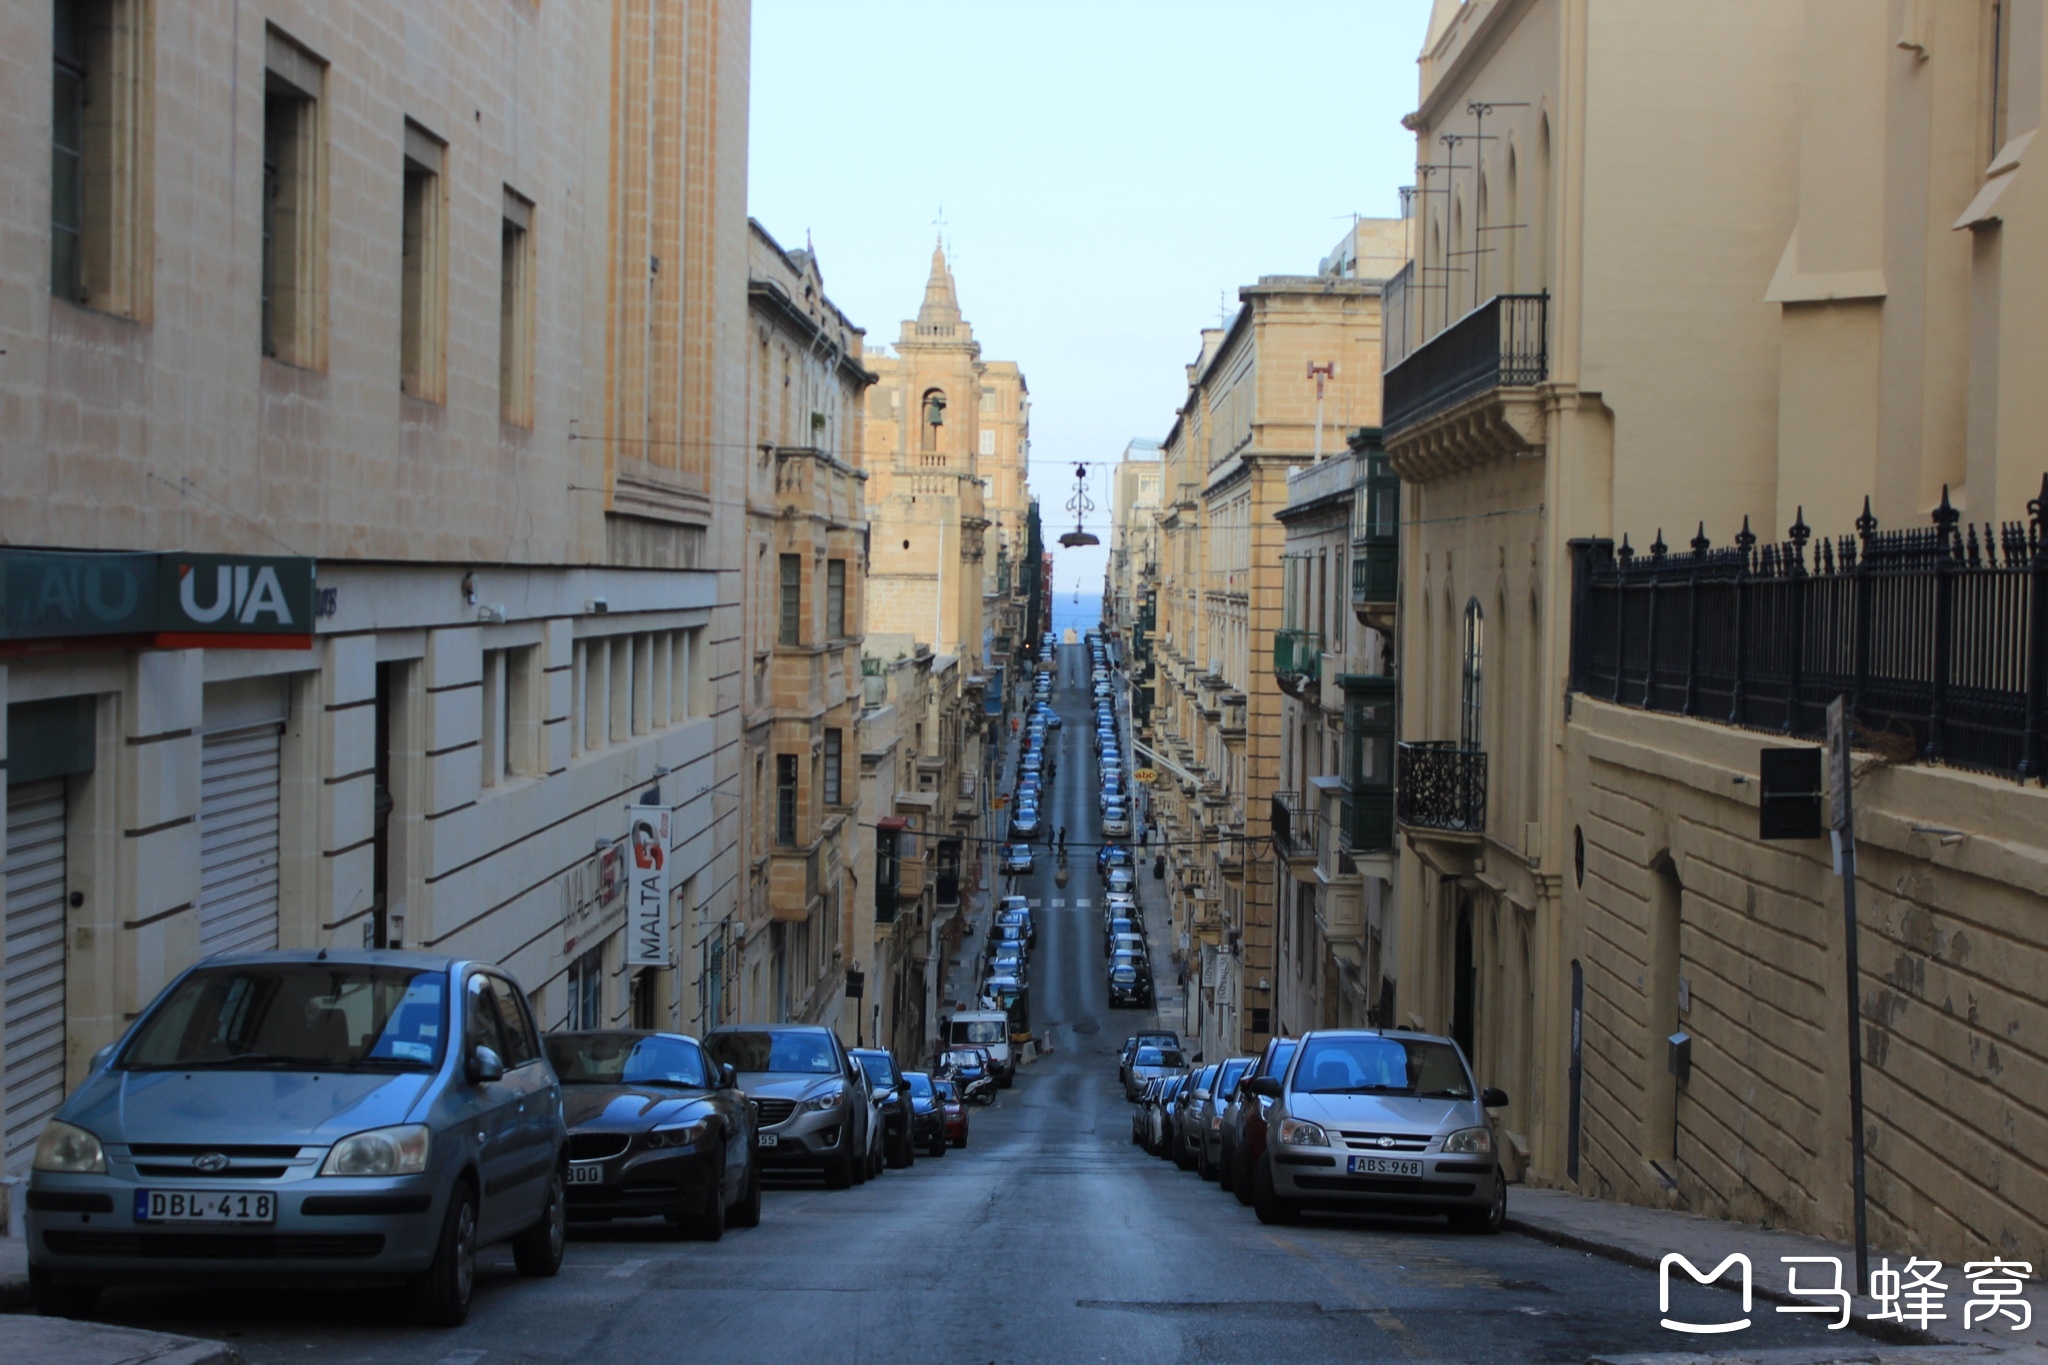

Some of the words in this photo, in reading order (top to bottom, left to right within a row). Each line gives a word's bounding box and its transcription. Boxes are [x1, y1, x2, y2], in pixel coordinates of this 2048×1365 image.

[179, 564, 294, 624] UIA
[1135, 771, 1154, 779] abc
[640, 875, 661, 959] MALTA
[1218, 957, 1229, 1000] IMPERIUM
[758, 1135, 775, 1145] 55
[1357, 1158, 1386, 1173] ABS
[1391, 1161, 1418, 1175] 968
[152, 1193, 204, 1217] DBL
[218, 1195, 270, 1218] 418
